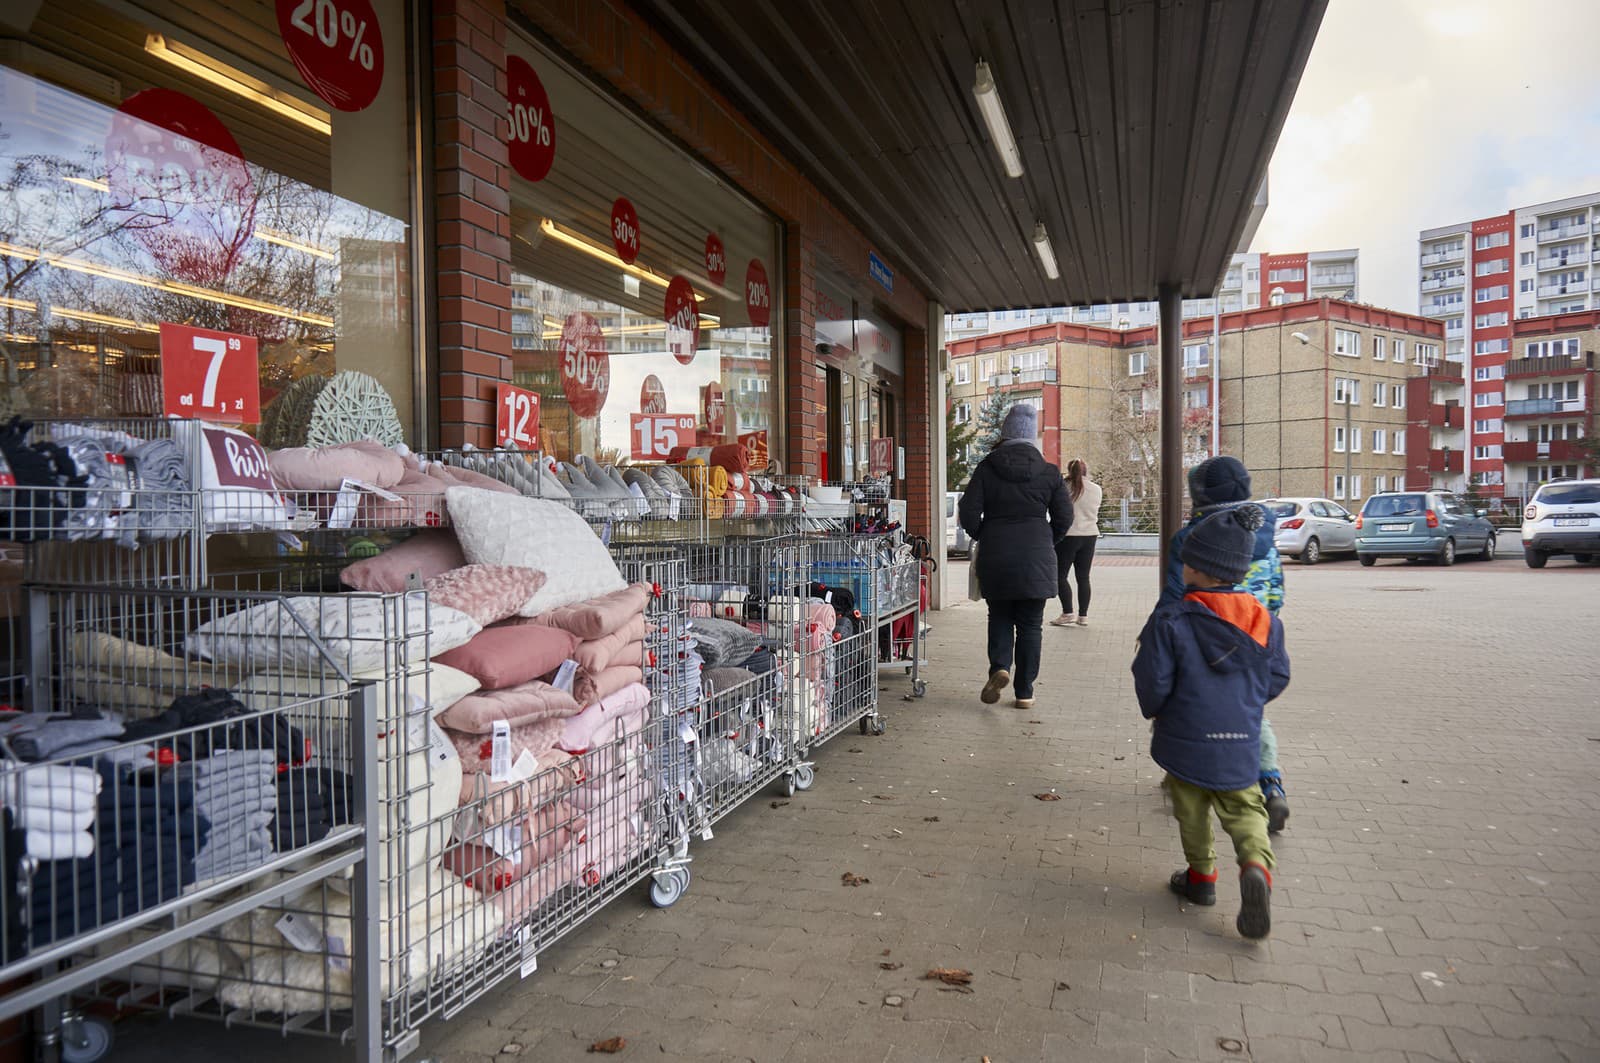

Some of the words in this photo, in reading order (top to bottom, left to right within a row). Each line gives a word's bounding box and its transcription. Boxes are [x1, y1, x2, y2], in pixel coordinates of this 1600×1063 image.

[290, 0, 374, 71] 20%
[614, 216, 637, 250] 30%
[707, 253, 724, 272] 30%
[748, 281, 769, 308] 20%
[180, 393, 193, 405] od
[228, 338, 241, 351] 99
[564, 343, 605, 394] 50%
[634, 417, 679, 455] 15
[679, 418, 694, 429] 00
[874, 441, 888, 467] 12
